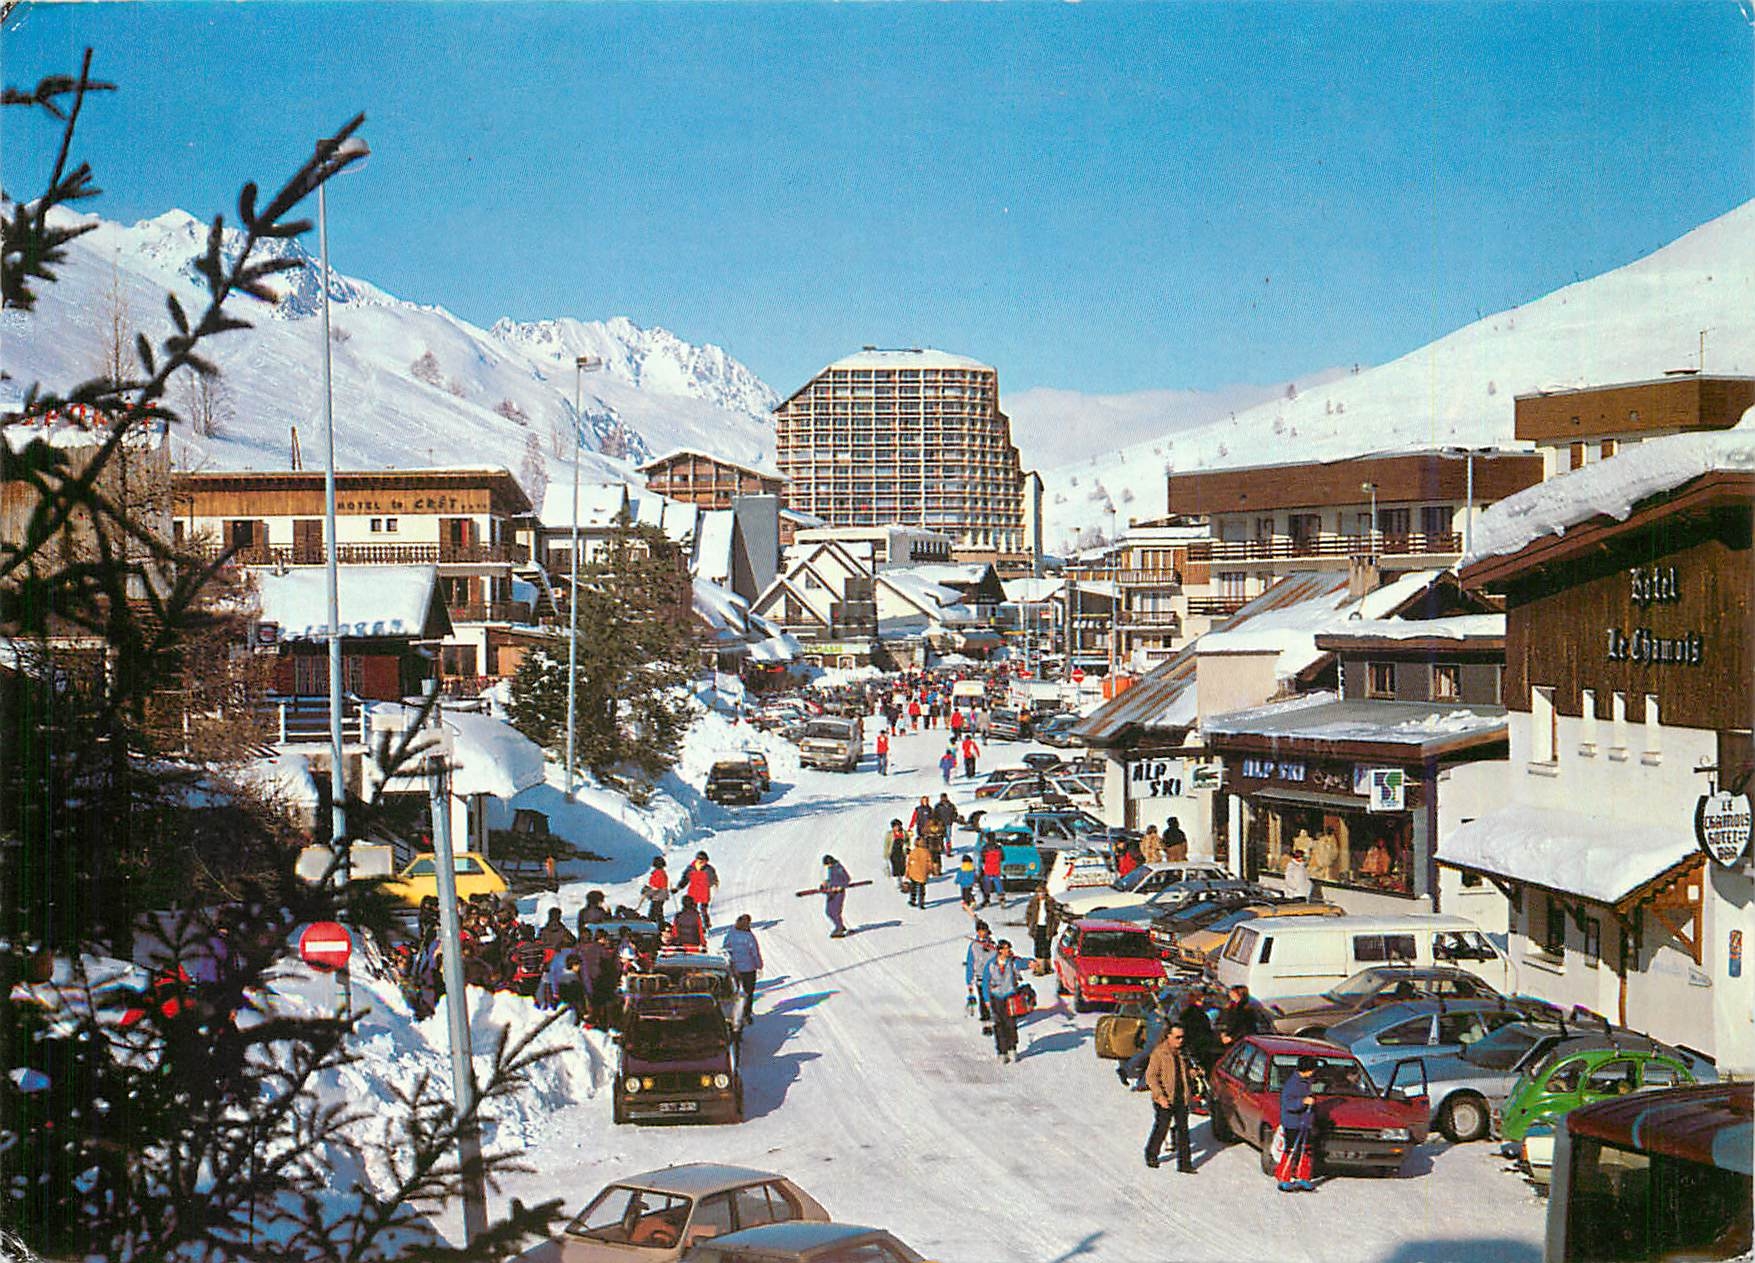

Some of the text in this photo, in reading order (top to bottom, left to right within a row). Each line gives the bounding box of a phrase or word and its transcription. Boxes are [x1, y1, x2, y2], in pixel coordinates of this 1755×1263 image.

[1132, 763, 1167, 781] ALP
[1243, 760, 1274, 778] ALP
[1278, 763, 1306, 781] SKI
[1150, 778, 1181, 796] SKI
